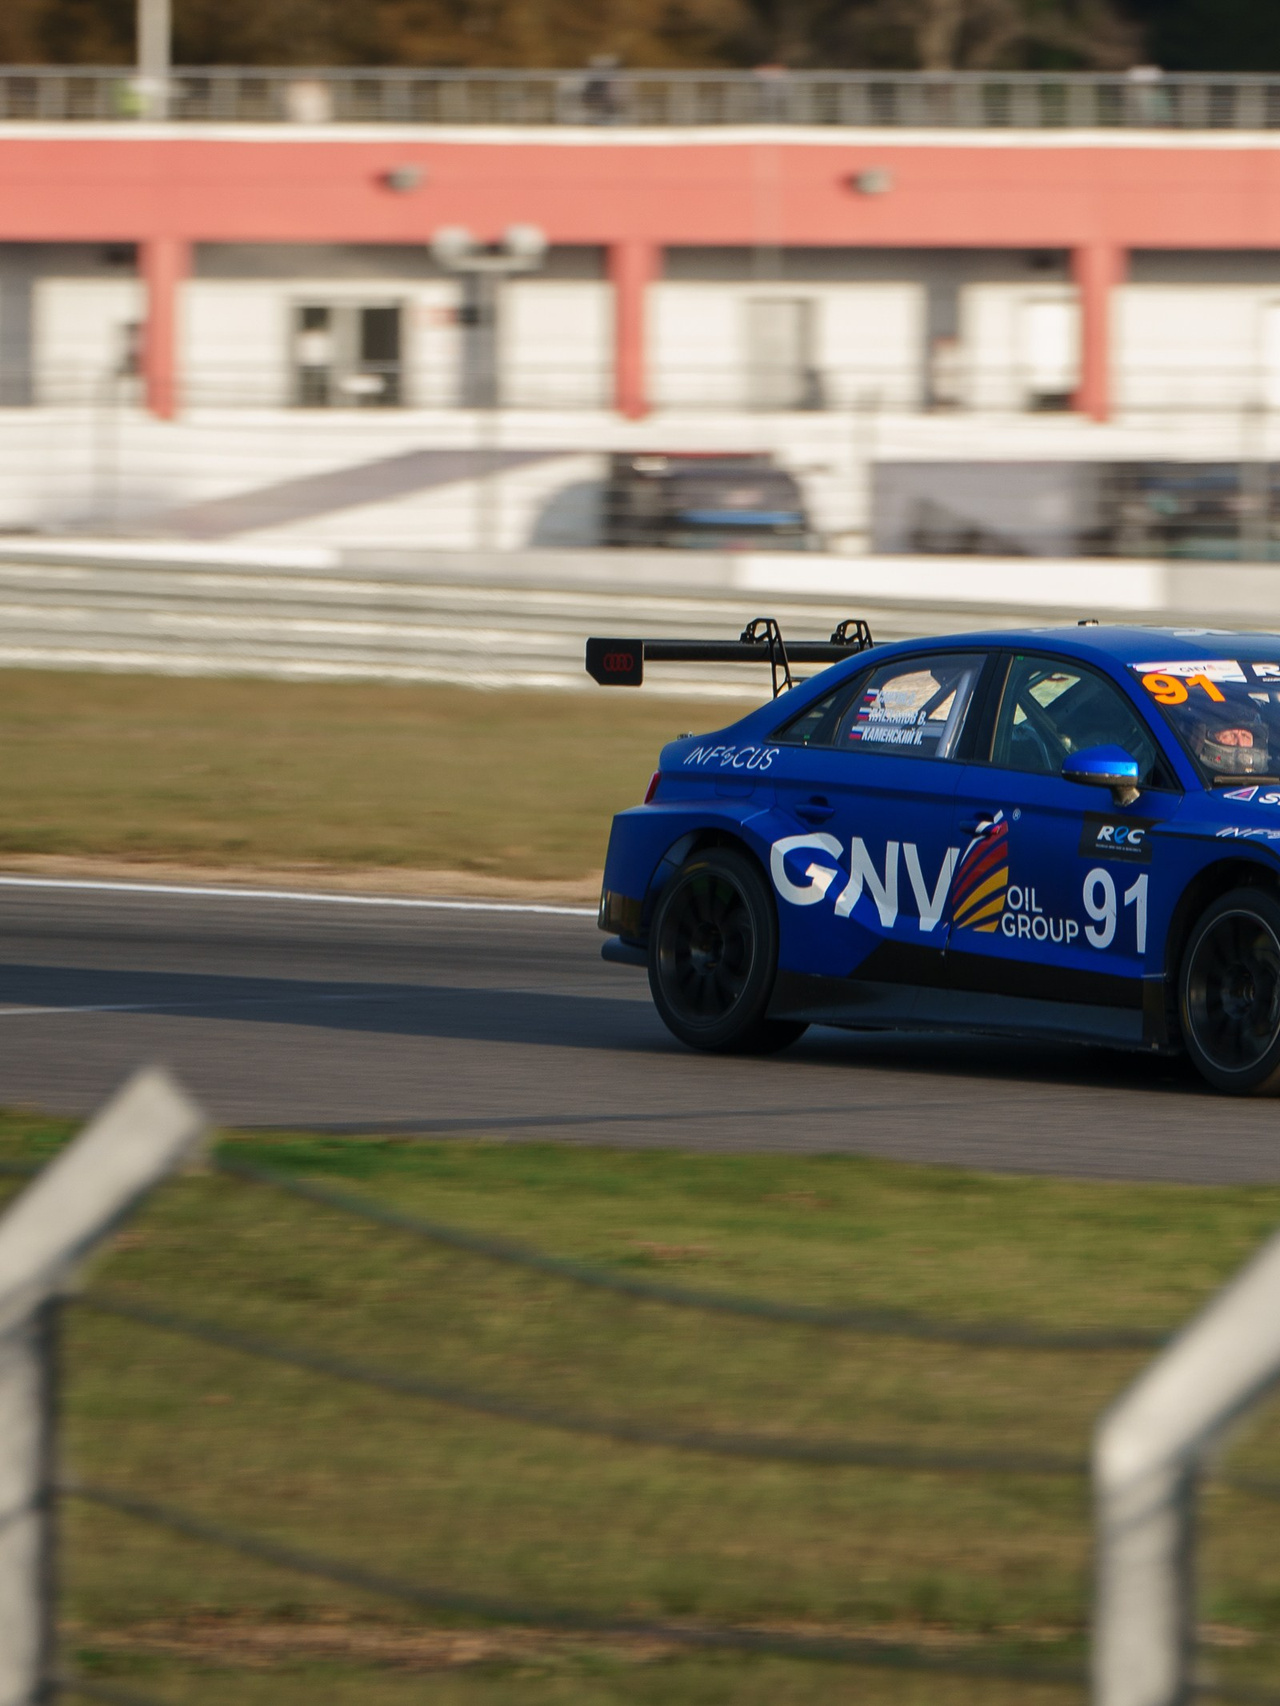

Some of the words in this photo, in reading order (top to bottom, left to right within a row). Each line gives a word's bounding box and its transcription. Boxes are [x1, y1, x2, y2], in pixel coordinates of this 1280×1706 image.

[1142, 673, 1226, 705] 91
[861, 727, 916, 743] КАМЕНСКИЙ
[770, 832, 960, 932] GNV
[1007, 885, 1043, 913] OIL
[1083, 867, 1149, 954] 91
[1001, 912, 1079, 944] GROUP
